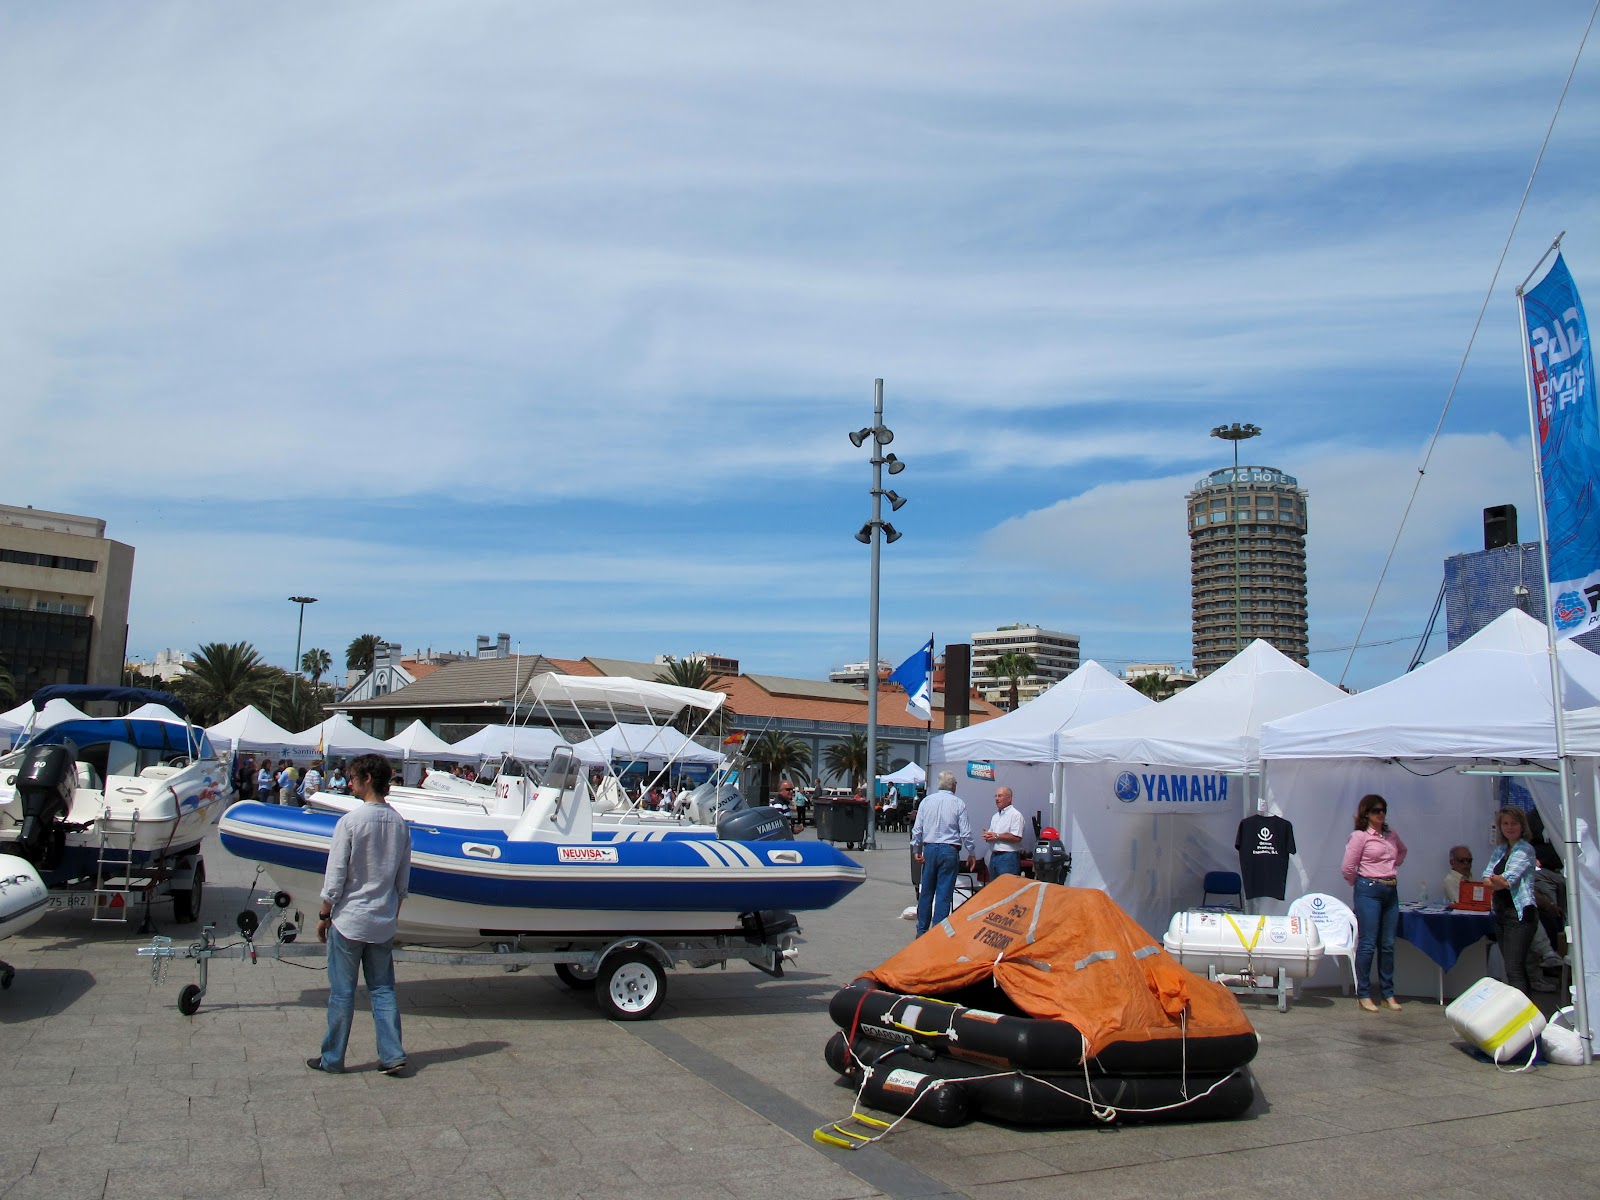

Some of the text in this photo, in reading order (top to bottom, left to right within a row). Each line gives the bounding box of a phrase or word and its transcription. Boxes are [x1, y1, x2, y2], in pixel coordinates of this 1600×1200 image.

[1141, 774, 1228, 802] YAMAHA
[709, 793, 739, 813] HONDA
[756, 819, 784, 835] YAMAHA
[562, 848, 602, 858] NEUVISA
[67, 896, 86, 907] BRZ
[862, 1025, 914, 1045] BOARDING
